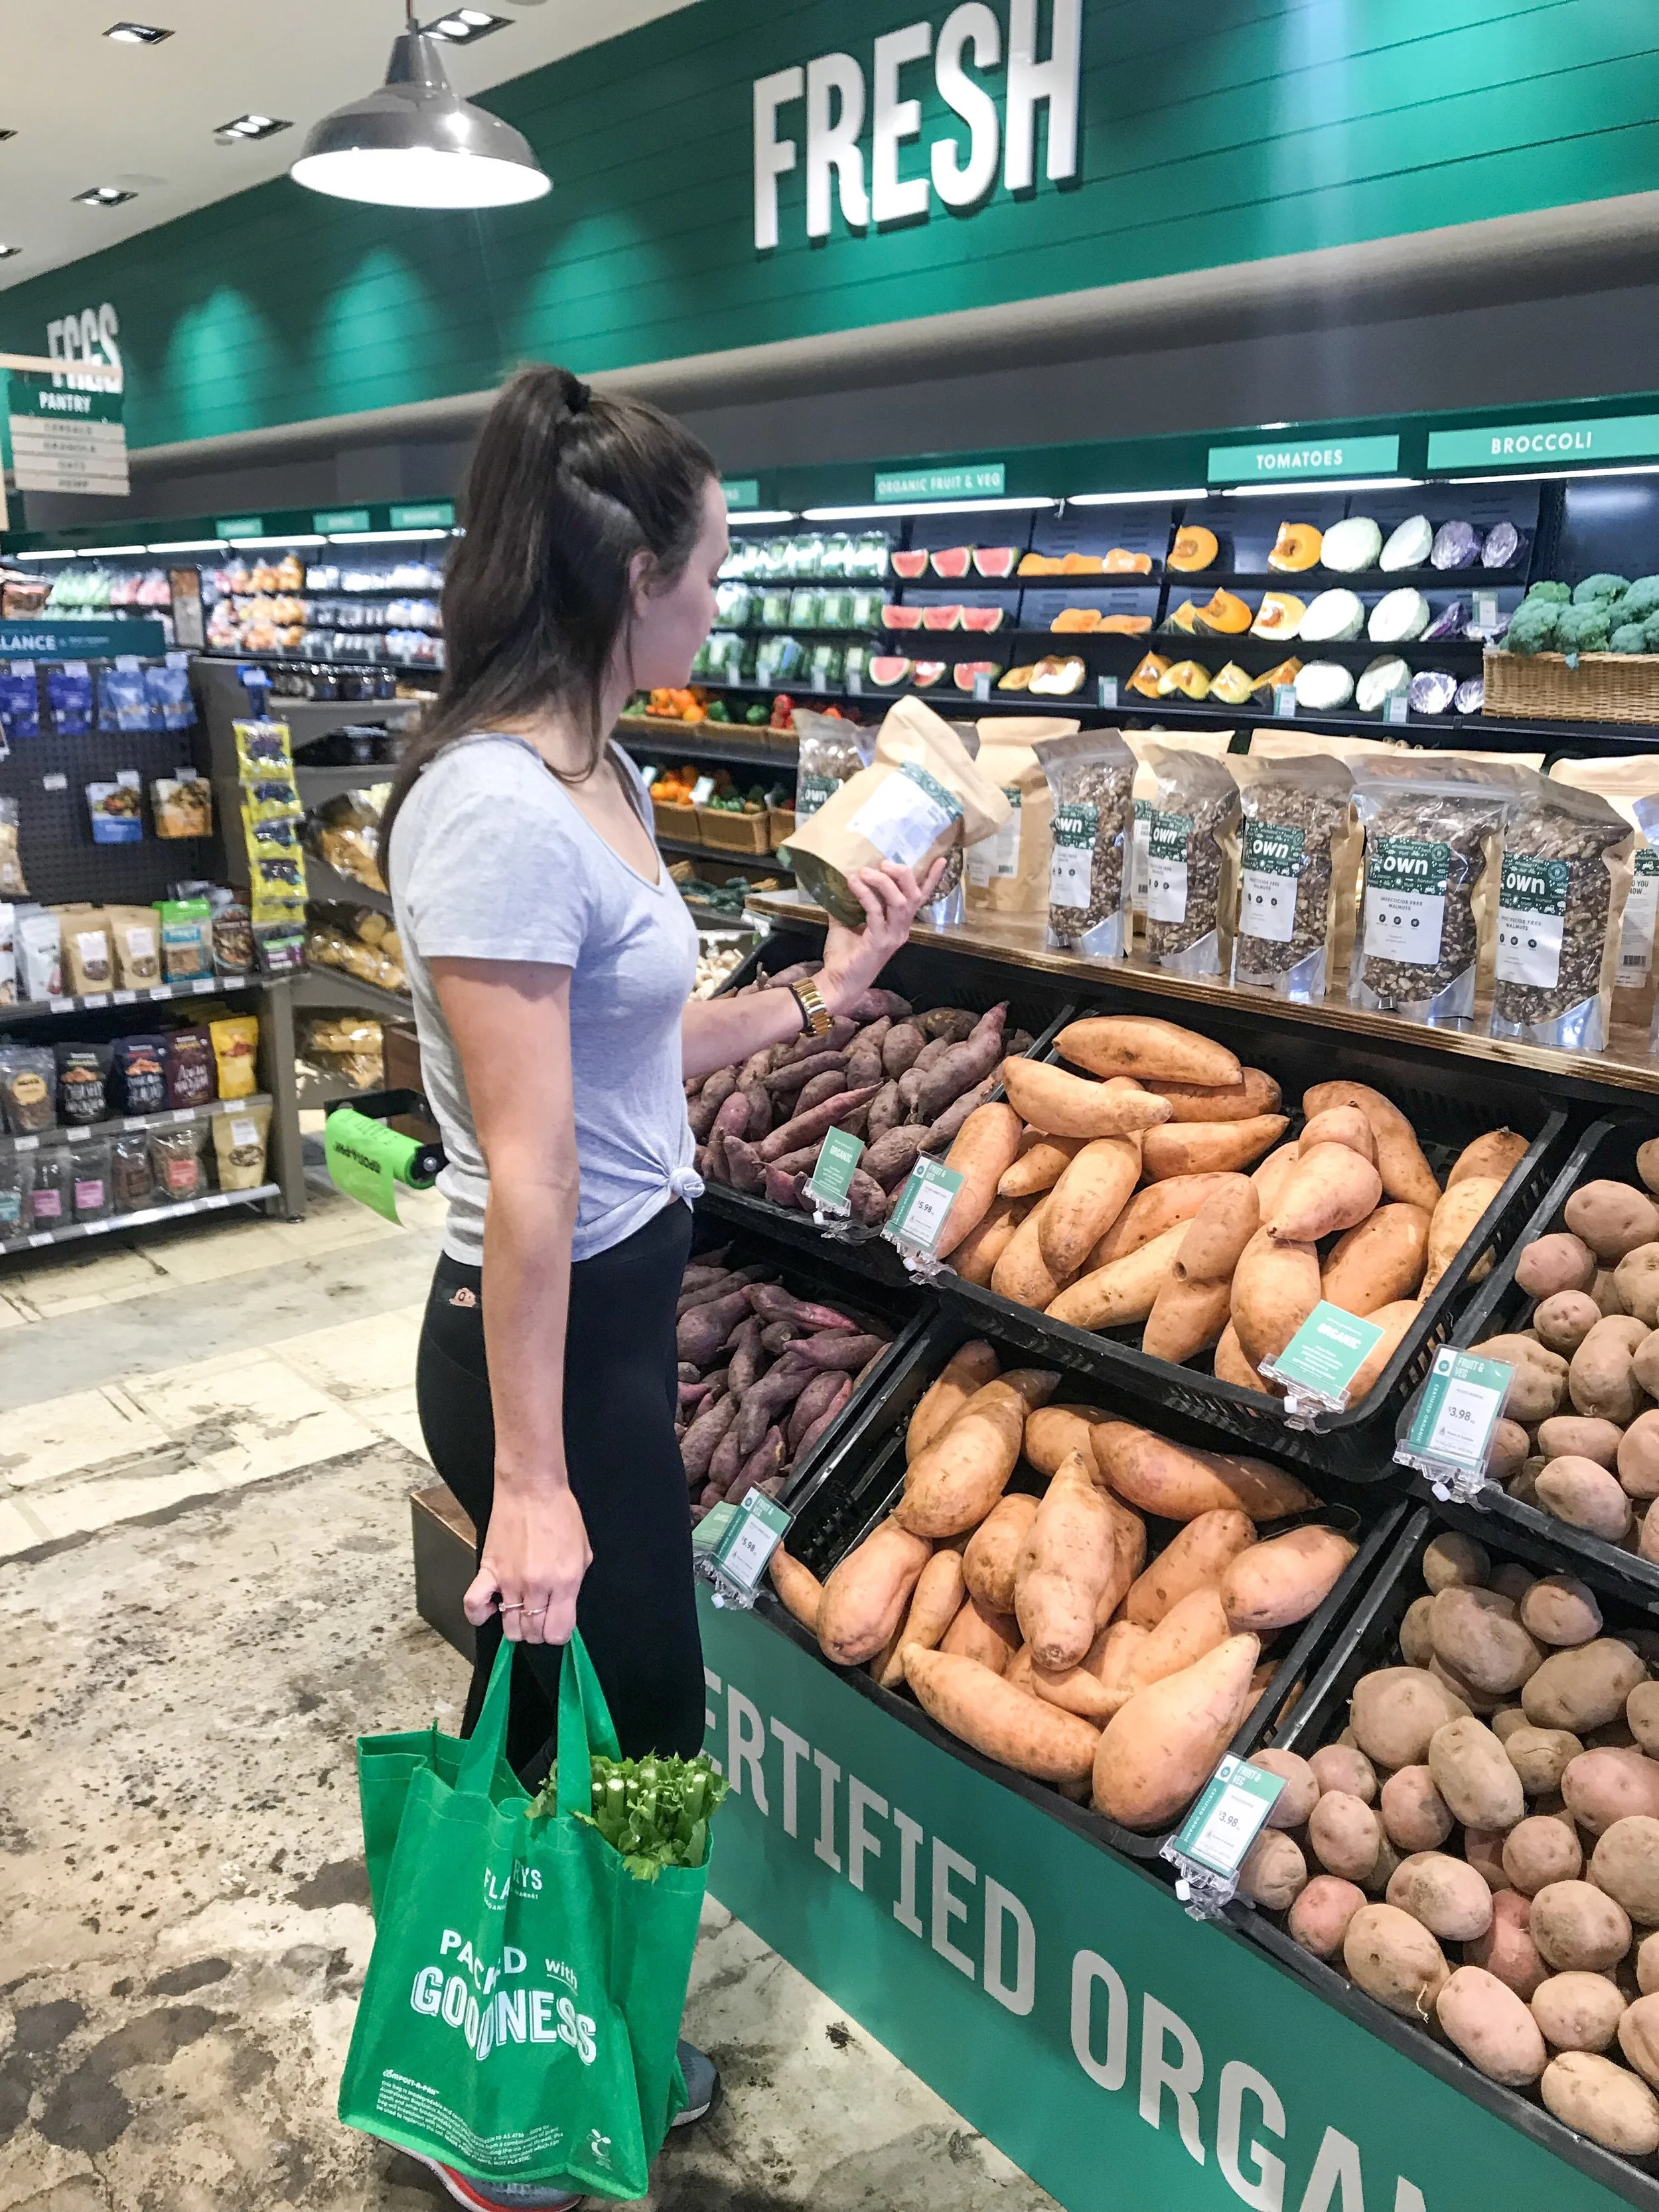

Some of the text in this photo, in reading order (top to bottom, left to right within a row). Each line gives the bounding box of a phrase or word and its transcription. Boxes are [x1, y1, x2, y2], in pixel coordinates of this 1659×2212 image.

[754, 0, 1082, 250] FRESH
[38, 391, 92, 413] PANTRY
[1490, 431, 1593, 455] BROCCOLI
[1257, 449, 1342, 470] TOMATOES
[878, 479, 927, 494] ORGANIC
[930, 475, 961, 490] FRUIT
[977, 472, 1001, 486] VEG
[0, 635, 56, 651] LANCE
[1055, 817, 1082, 833] own
[1153, 827, 1177, 845] own
[1253, 840, 1289, 858] own
[1384, 856, 1428, 875] own
[1506, 873, 1545, 895] own
[830, 1145, 853, 1163] ORGANIC
[1317, 1323, 1361, 1350] ORGANIC
[1455, 1367, 1468, 1378] VEG
[1457, 1357, 1484, 1372] FRUIT &
[1417, 1383, 1439, 1442] CERTIFIED ORGANIC
[1448, 1406, 1471, 1421] $3.98
[1232, 1775, 1246, 1786] VEG
[1238, 1765, 1258, 1780] FRUIT
[1183, 1788, 1217, 1842] CERTIFIED ORGANIC
[1219, 1810, 1238, 1827] $3.98
[440, 1929, 577, 1994] PACKD with
[411, 1966, 596, 2065] GOODNESS
[1070, 1949, 1427, 2212] ORGA
